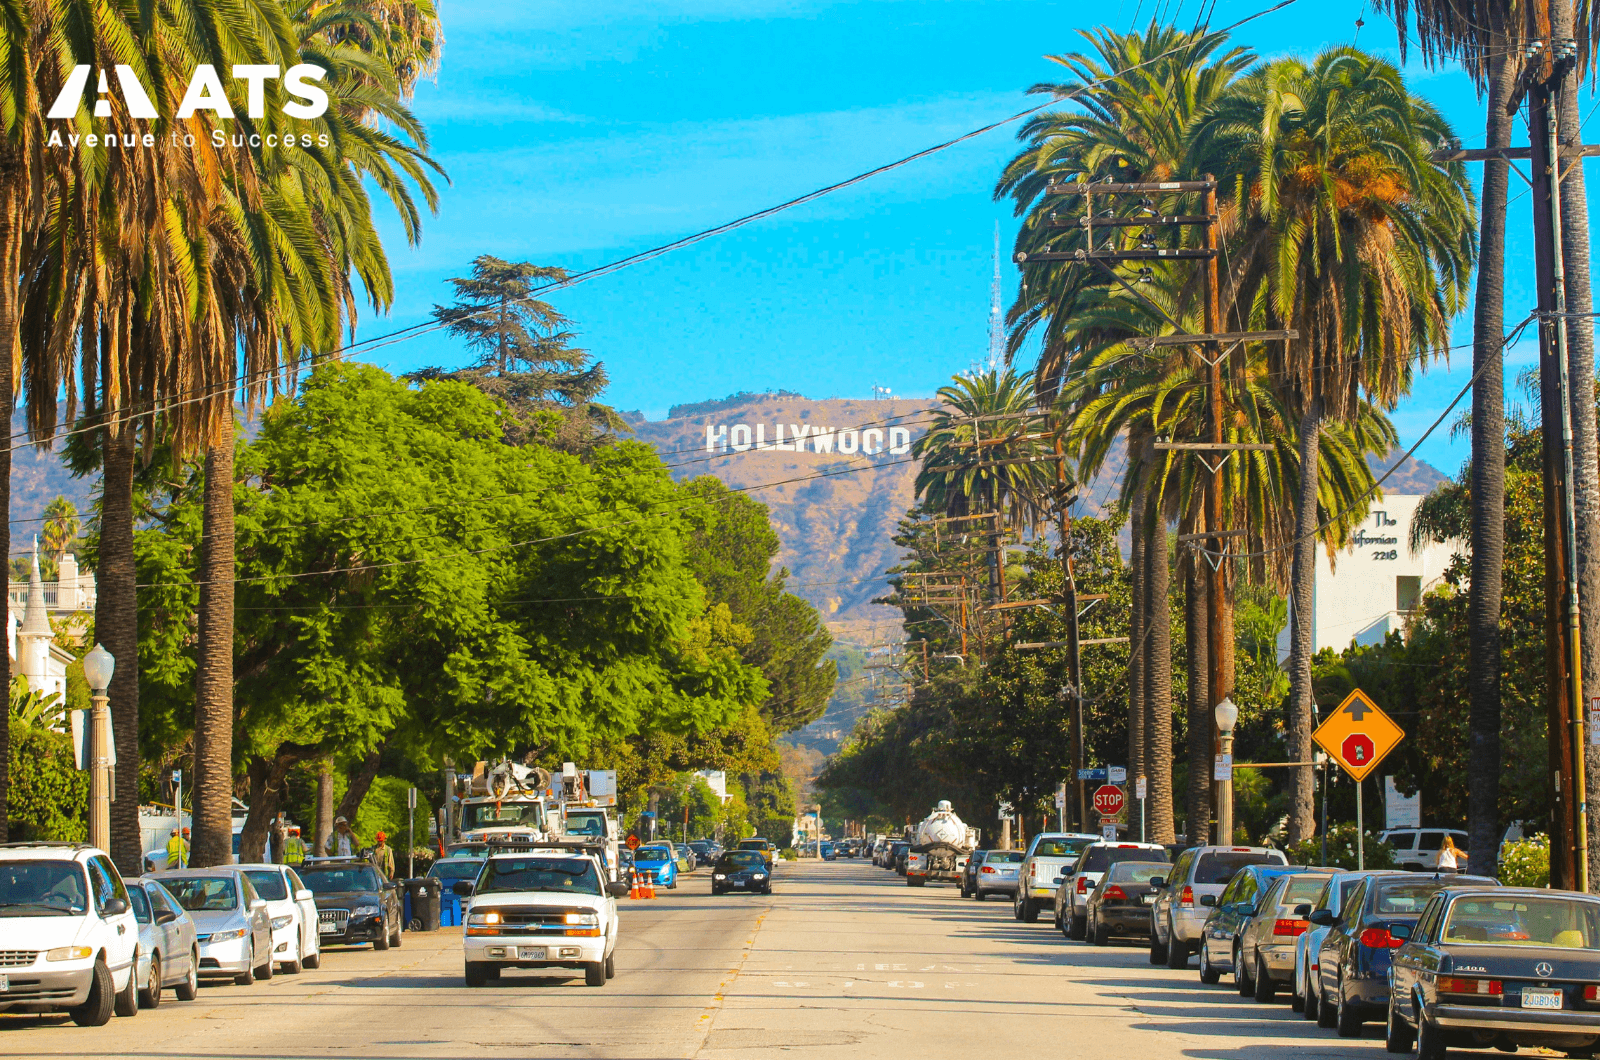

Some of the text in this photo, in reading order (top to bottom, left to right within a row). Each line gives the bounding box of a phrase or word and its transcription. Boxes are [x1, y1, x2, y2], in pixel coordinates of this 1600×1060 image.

[706, 423, 910, 455] HOLLYWOOD
[1371, 511, 1397, 528] The
[1352, 529, 1398, 549] lifornian
[1371, 549, 1398, 561] 2218
[1096, 794, 1122, 806] STOP
